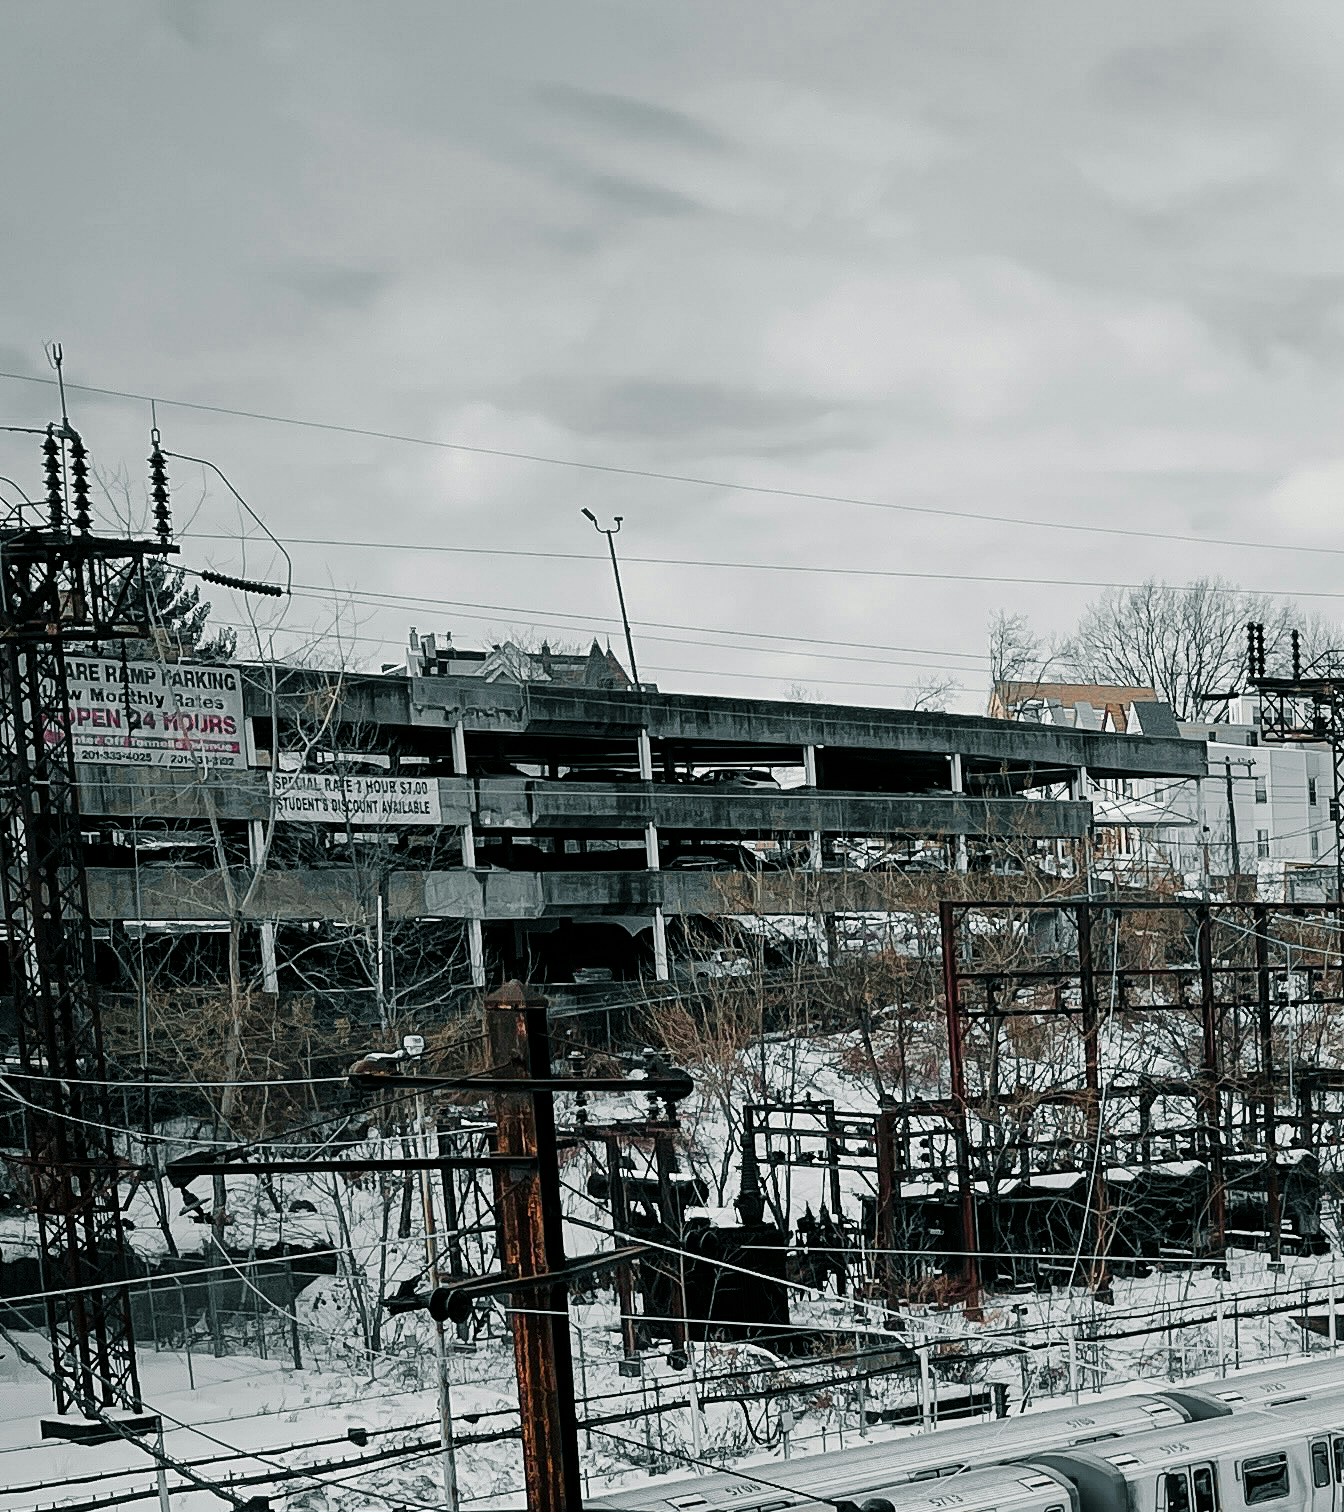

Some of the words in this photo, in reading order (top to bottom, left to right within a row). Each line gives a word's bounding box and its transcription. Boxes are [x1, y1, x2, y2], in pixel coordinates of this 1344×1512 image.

[161, 669, 237, 691] PARKING
[163, 711, 237, 735] HOURS
[331, 799, 378, 814] DISCOUNT
[382, 800, 430, 815] AVAILABLE
